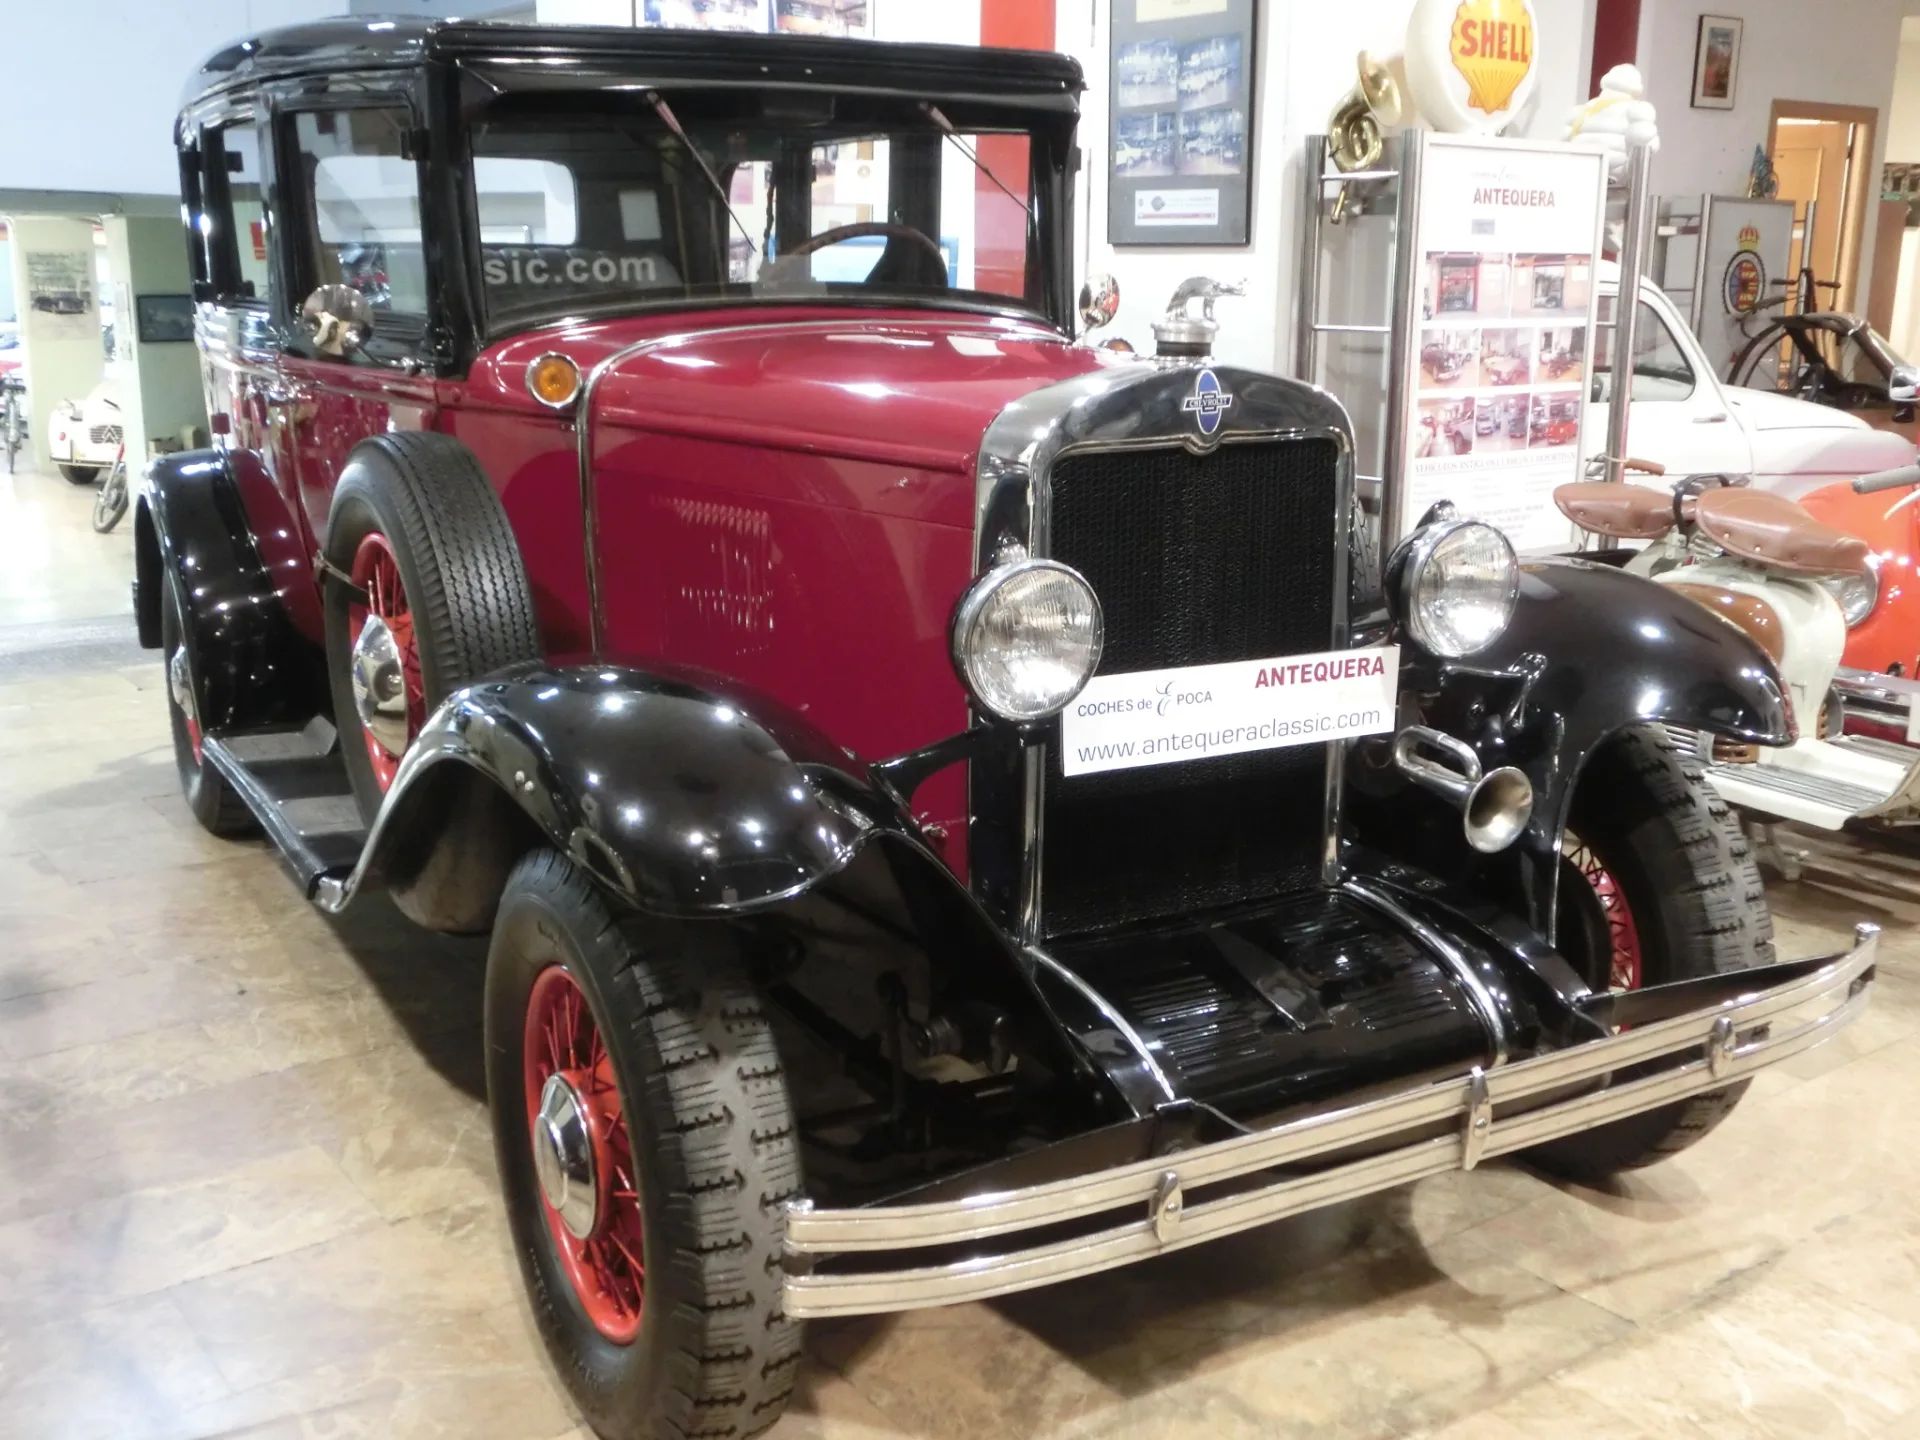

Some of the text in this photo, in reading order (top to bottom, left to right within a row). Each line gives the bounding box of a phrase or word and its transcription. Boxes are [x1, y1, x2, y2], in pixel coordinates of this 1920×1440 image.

[1459, 19, 1528, 63] SHELL
[1473, 187, 1555, 207] ANTEQUERA
[1255, 656, 1385, 688] ANTEQUERA
[1078, 699, 1134, 717] COCHES
[1137, 698, 1153, 711] de
[1078, 710, 1380, 762] www.antequeraclassic.com
